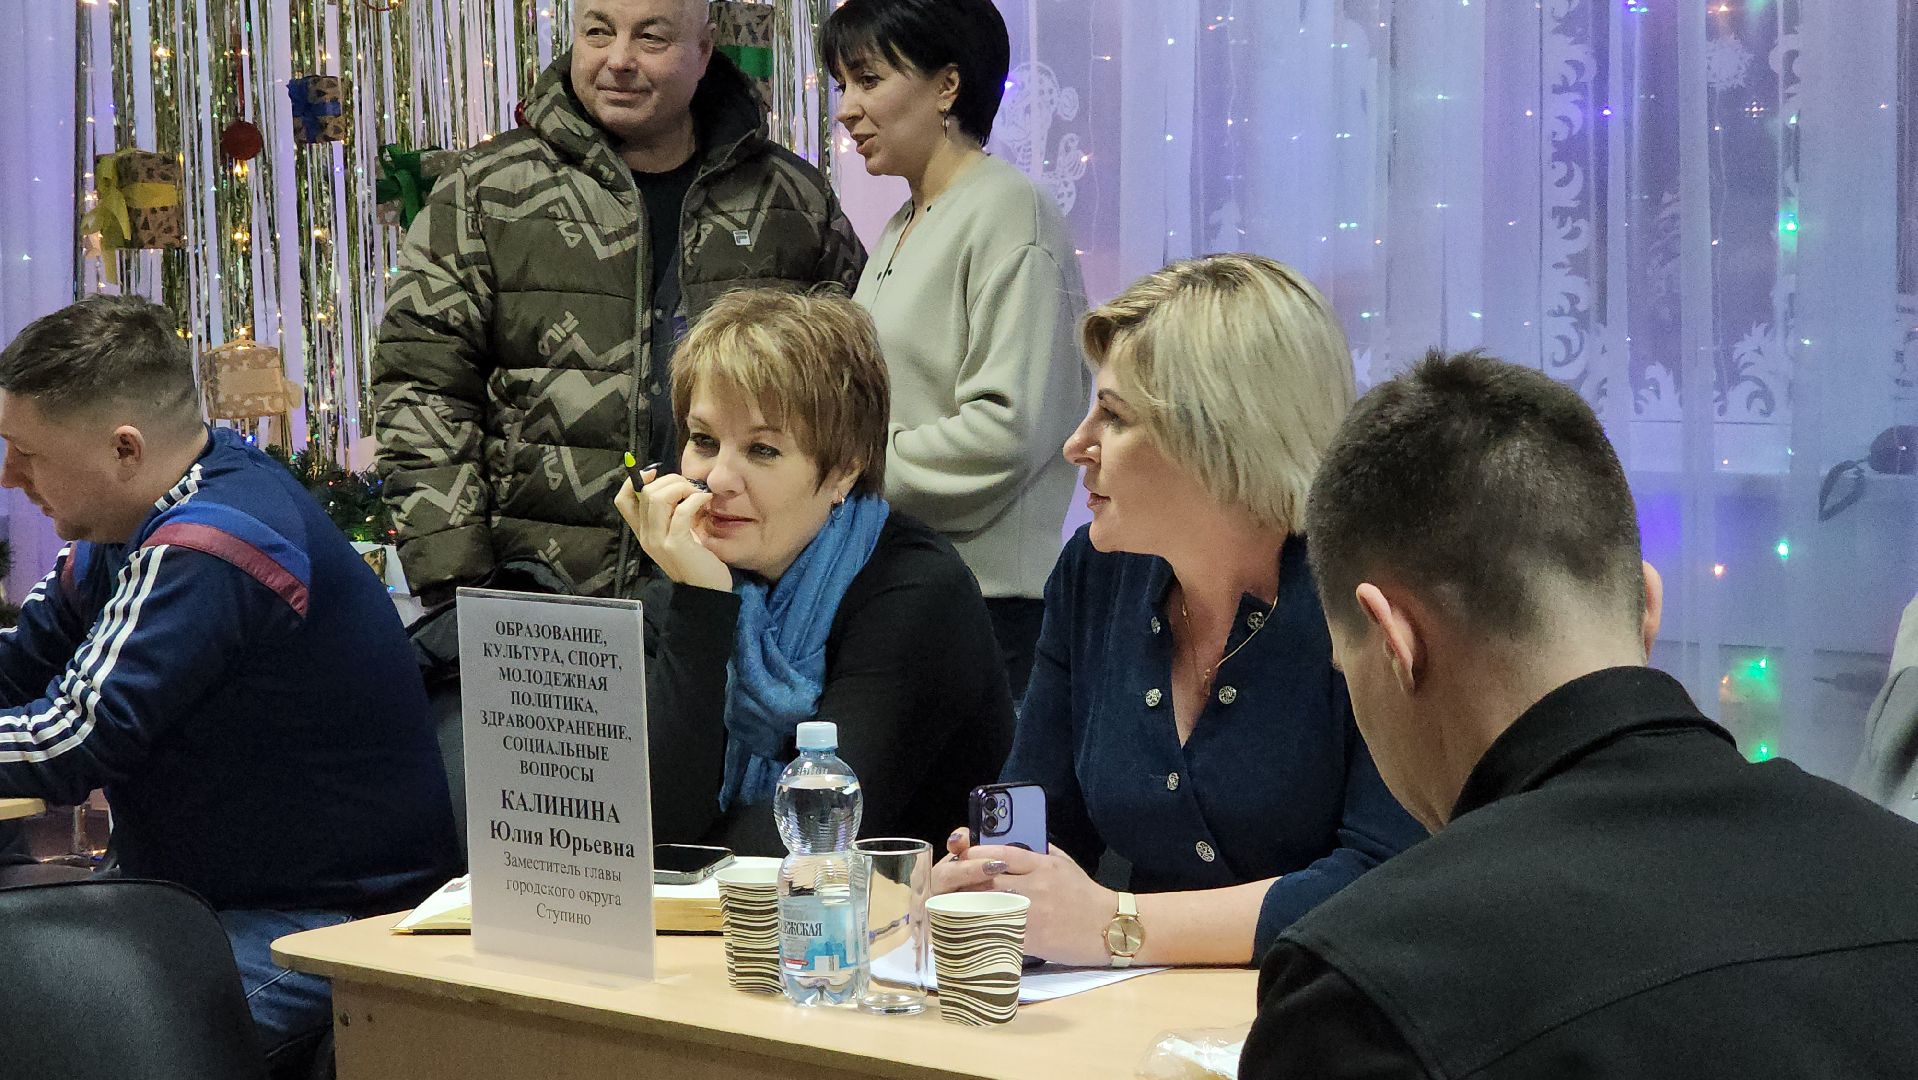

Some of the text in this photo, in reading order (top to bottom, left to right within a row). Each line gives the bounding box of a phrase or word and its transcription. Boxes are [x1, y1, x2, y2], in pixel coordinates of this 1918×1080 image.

[537, 310, 580, 357] FILA
[495, 620, 608, 647] ОБРАЗОВАНИЕ,
[483, 642, 622, 671] КУЛЬТУРА, СПОРТ,
[498, 666, 609, 692] МОЛОДЕЖНАЯ
[510, 690, 599, 715] ПОЛИТИКА,
[480, 709, 632, 742] ЗДРАВООХРАНЕНИЕ,
[502, 735, 610, 762] СОЦИАЛЬНЫЕ
[519, 760, 595, 783] ВОПРОСЫ
[500, 789, 621, 824] КАЛИНИНА
[490, 818, 636, 858] Юлия Юрьевна
[503, 850, 622, 883] Заместитель главы
[506, 878, 622, 908] городского округа
[536, 902, 592, 926] Ступино
